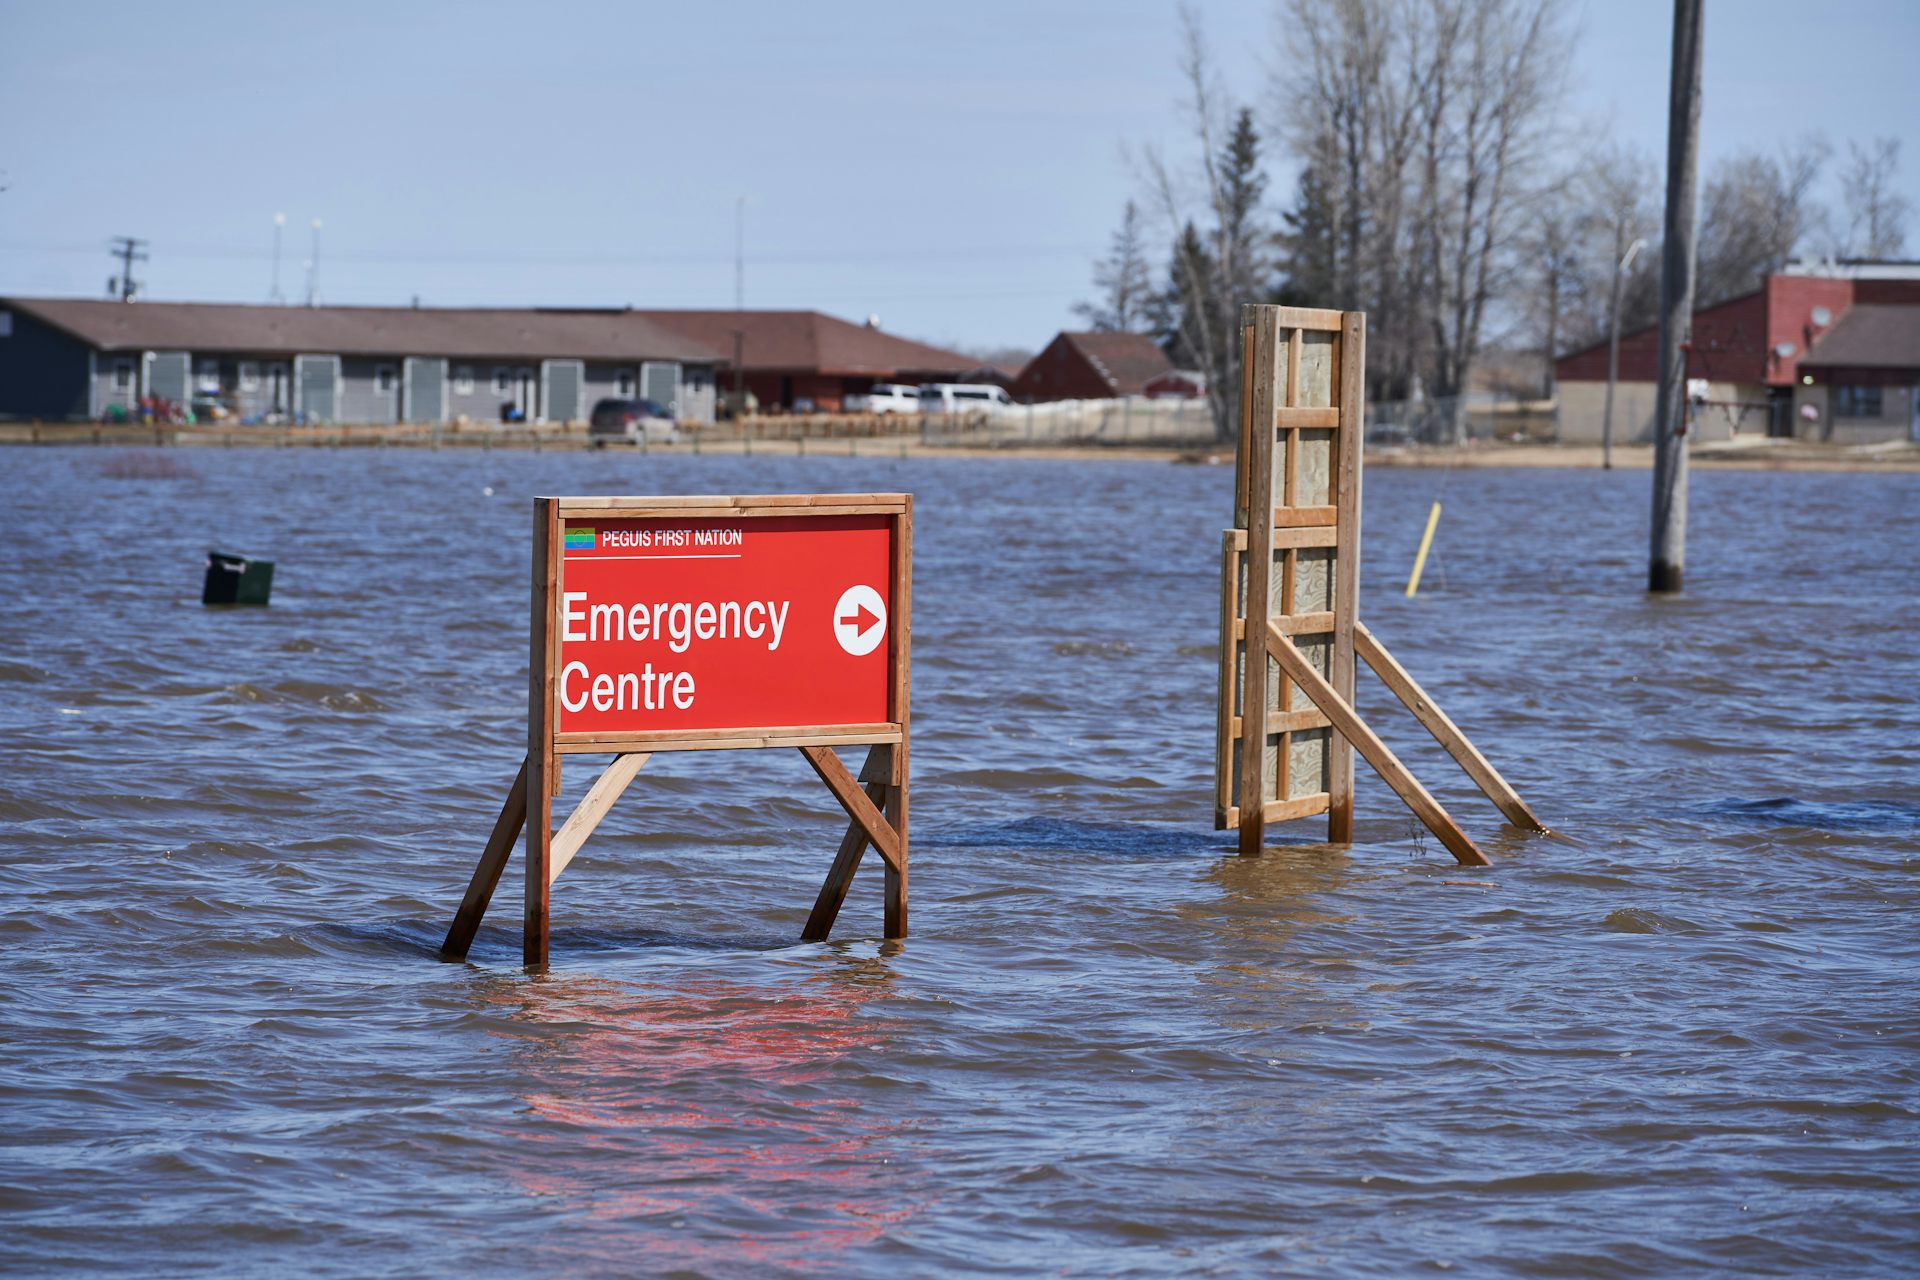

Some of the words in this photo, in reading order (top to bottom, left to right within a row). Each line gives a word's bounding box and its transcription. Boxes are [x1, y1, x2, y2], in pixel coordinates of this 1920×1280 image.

[602, 530, 651, 547] PEGUIS
[655, 529, 691, 546] FIRST
[695, 528, 742, 546] NATION
[562, 591, 790, 653] Emergency
[561, 660, 695, 712] Centre
